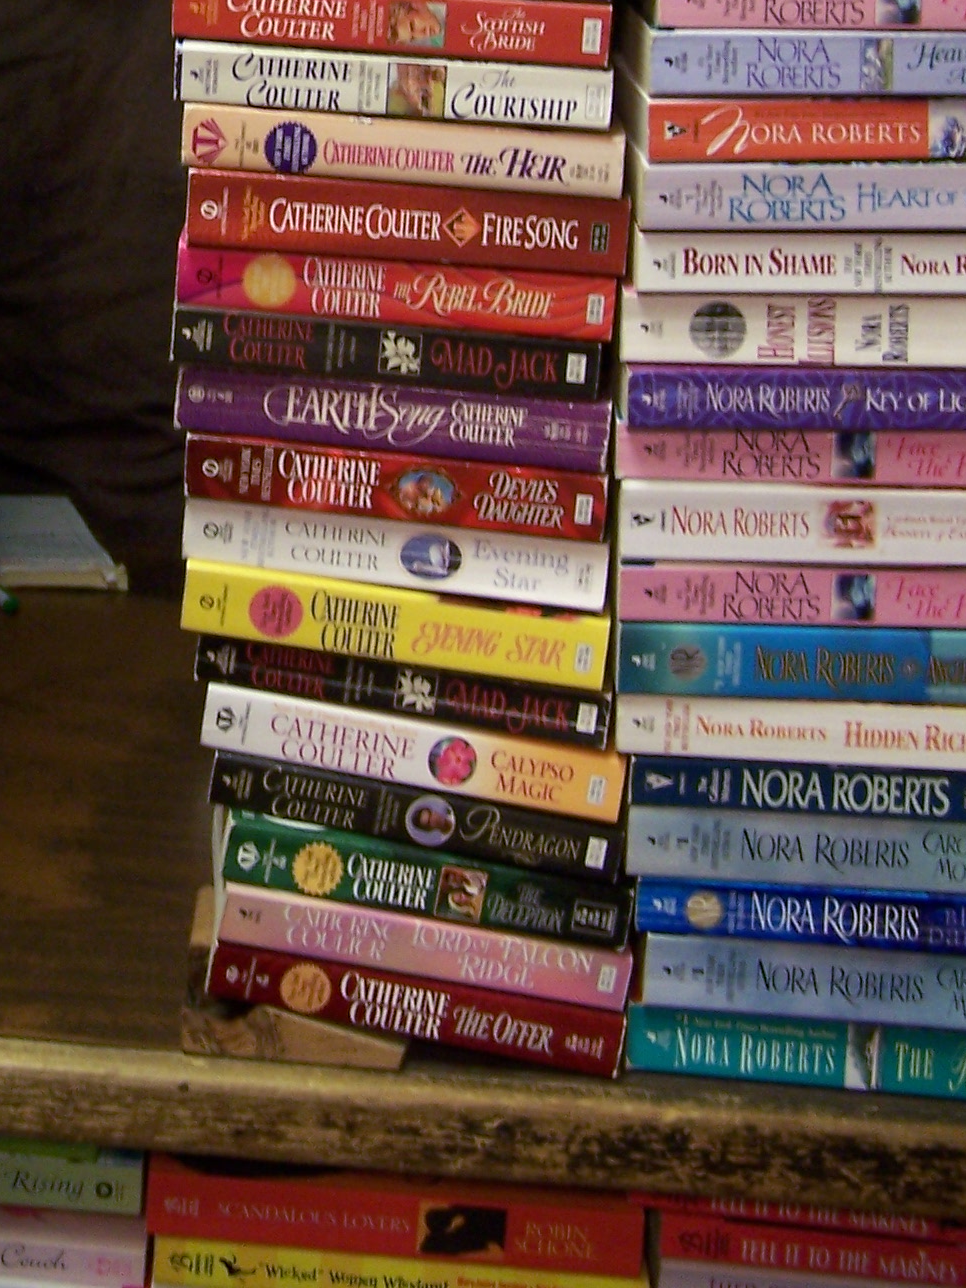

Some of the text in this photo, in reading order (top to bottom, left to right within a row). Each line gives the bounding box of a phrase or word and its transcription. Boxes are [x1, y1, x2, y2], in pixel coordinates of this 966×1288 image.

[449, 87, 577, 122] COURTSHIP
[811, 124, 922, 146] ROBERTS
[740, 172, 833, 196] NORA
[857, 183, 932, 213] HEART
[269, 198, 444, 242] CATHERINE COULTER
[728, 198, 847, 224] ROBERTS
[681, 248, 837, 277] BORN IN SHAME
[704, 388, 756, 415] NORA
[672, 505, 811, 540] NORA ROBERTS
[490, 750, 576, 783] CALYPSO
[494, 779, 561, 805] MAGIC
[740, 769, 953, 817] NORA ROBERTS
[750, 890, 817, 935] NORA
